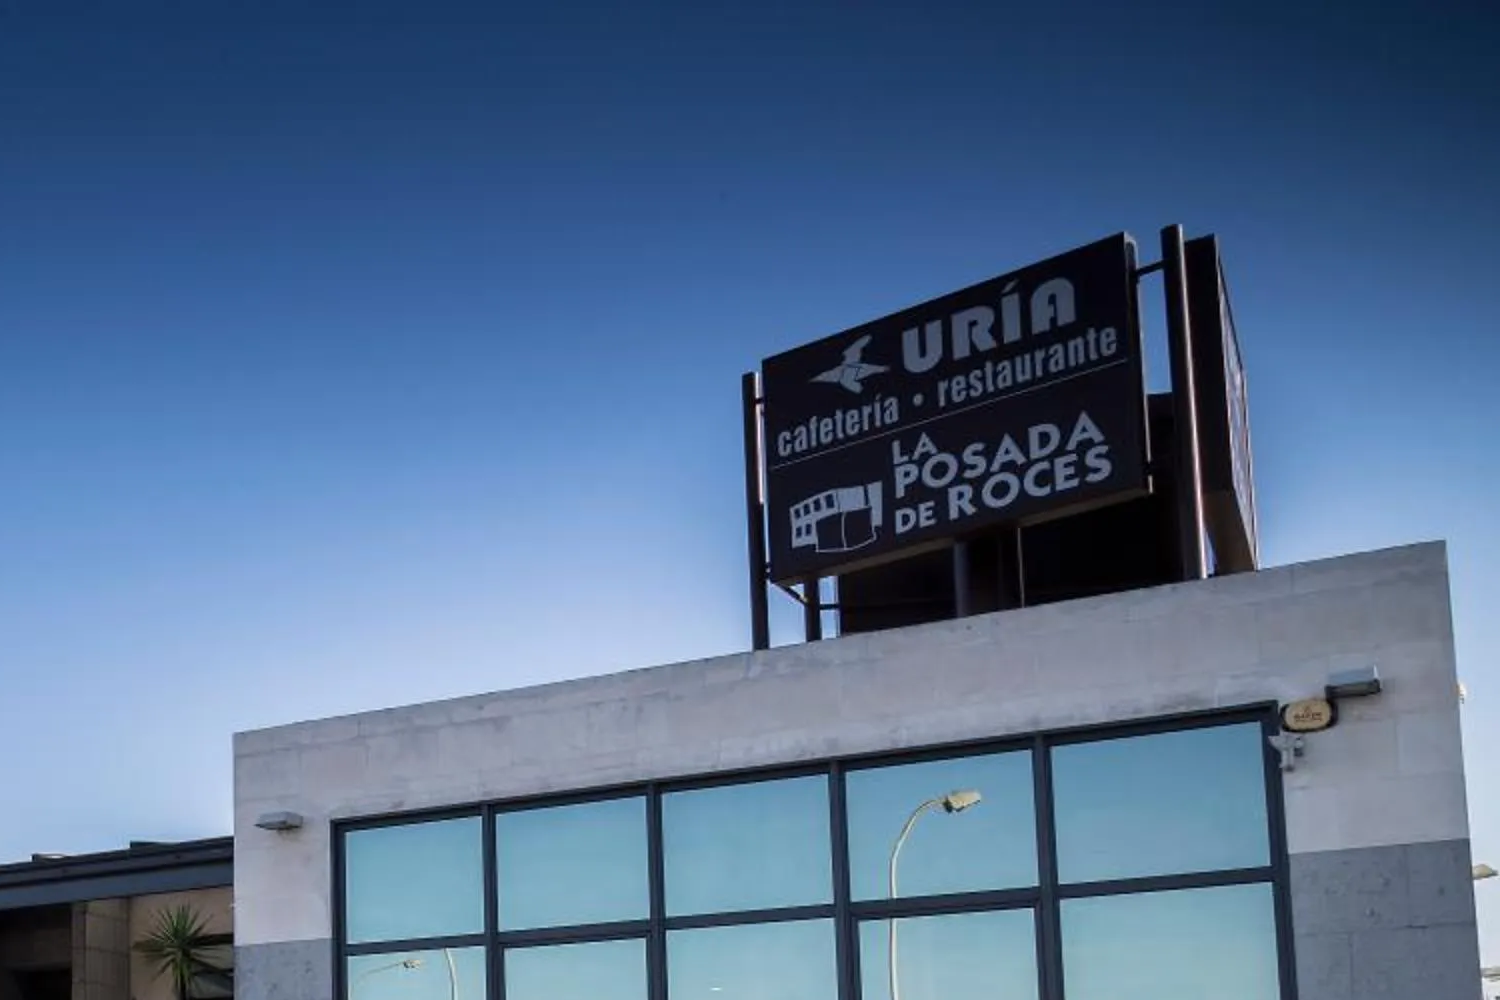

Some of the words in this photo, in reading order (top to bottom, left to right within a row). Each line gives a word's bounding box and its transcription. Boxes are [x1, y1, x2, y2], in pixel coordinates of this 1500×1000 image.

[902, 277, 1076, 373] URÍA
[777, 395, 898, 457] cafetería
[938, 326, 1117, 408] restaurante
[892, 432, 938, 464] LA
[895, 410, 1104, 499] POSADA
[895, 500, 937, 534] DE
[949, 445, 1112, 520] ROCES
